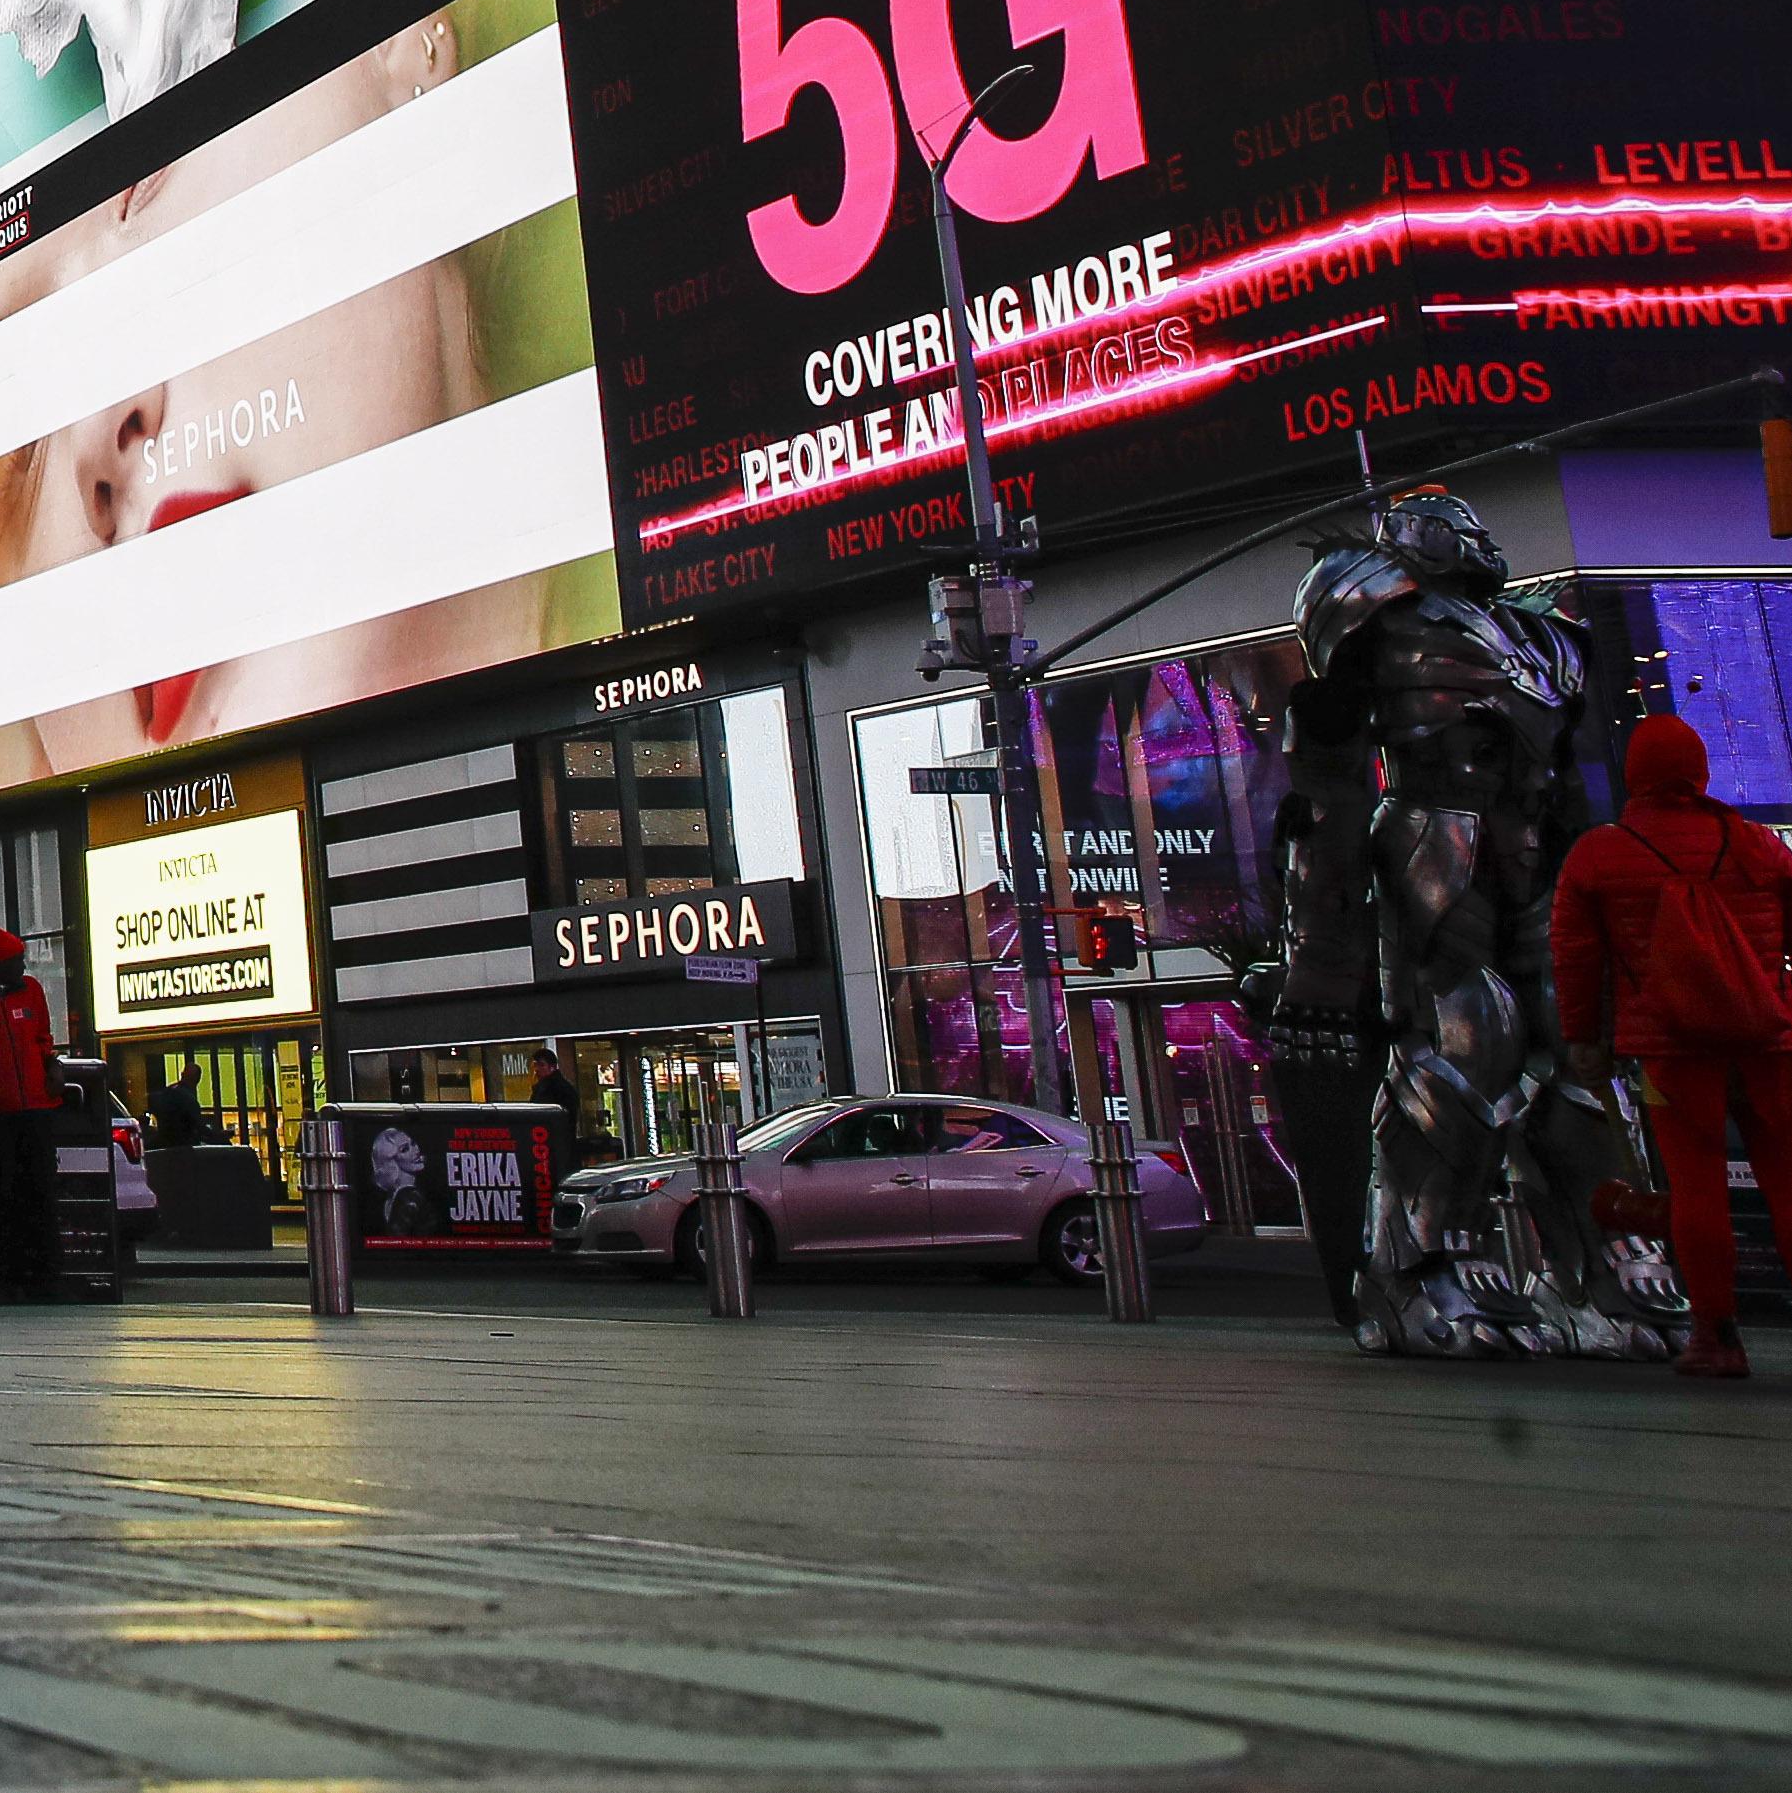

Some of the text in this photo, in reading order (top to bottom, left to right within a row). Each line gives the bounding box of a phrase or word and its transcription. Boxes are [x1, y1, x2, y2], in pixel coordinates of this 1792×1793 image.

[1380, 145, 1531, 193] ALTUS
[805, 231, 1179, 408] COVERING MORE
[1282, 360, 1552, 443] LOS ALAMOS
[142, 377, 308, 487] SEPHORA
[740, 404, 893, 502] PEOPLE
[826, 493, 964, 562] NEW YORK
[594, 662, 704, 712] SEPHORA
[143, 771, 238, 827] INVICTA
[930, 771, 978, 792] W 46
[158, 852, 218, 883] INVICTA
[115, 892, 266, 950] SHOP ONLINE AT
[555, 895, 766, 968] SEPHORA
[118, 956, 271, 1004] INVICTASTORES.COM
[445, 1152, 522, 1187] ERIKA
[449, 1190, 523, 1222] JAYNE
